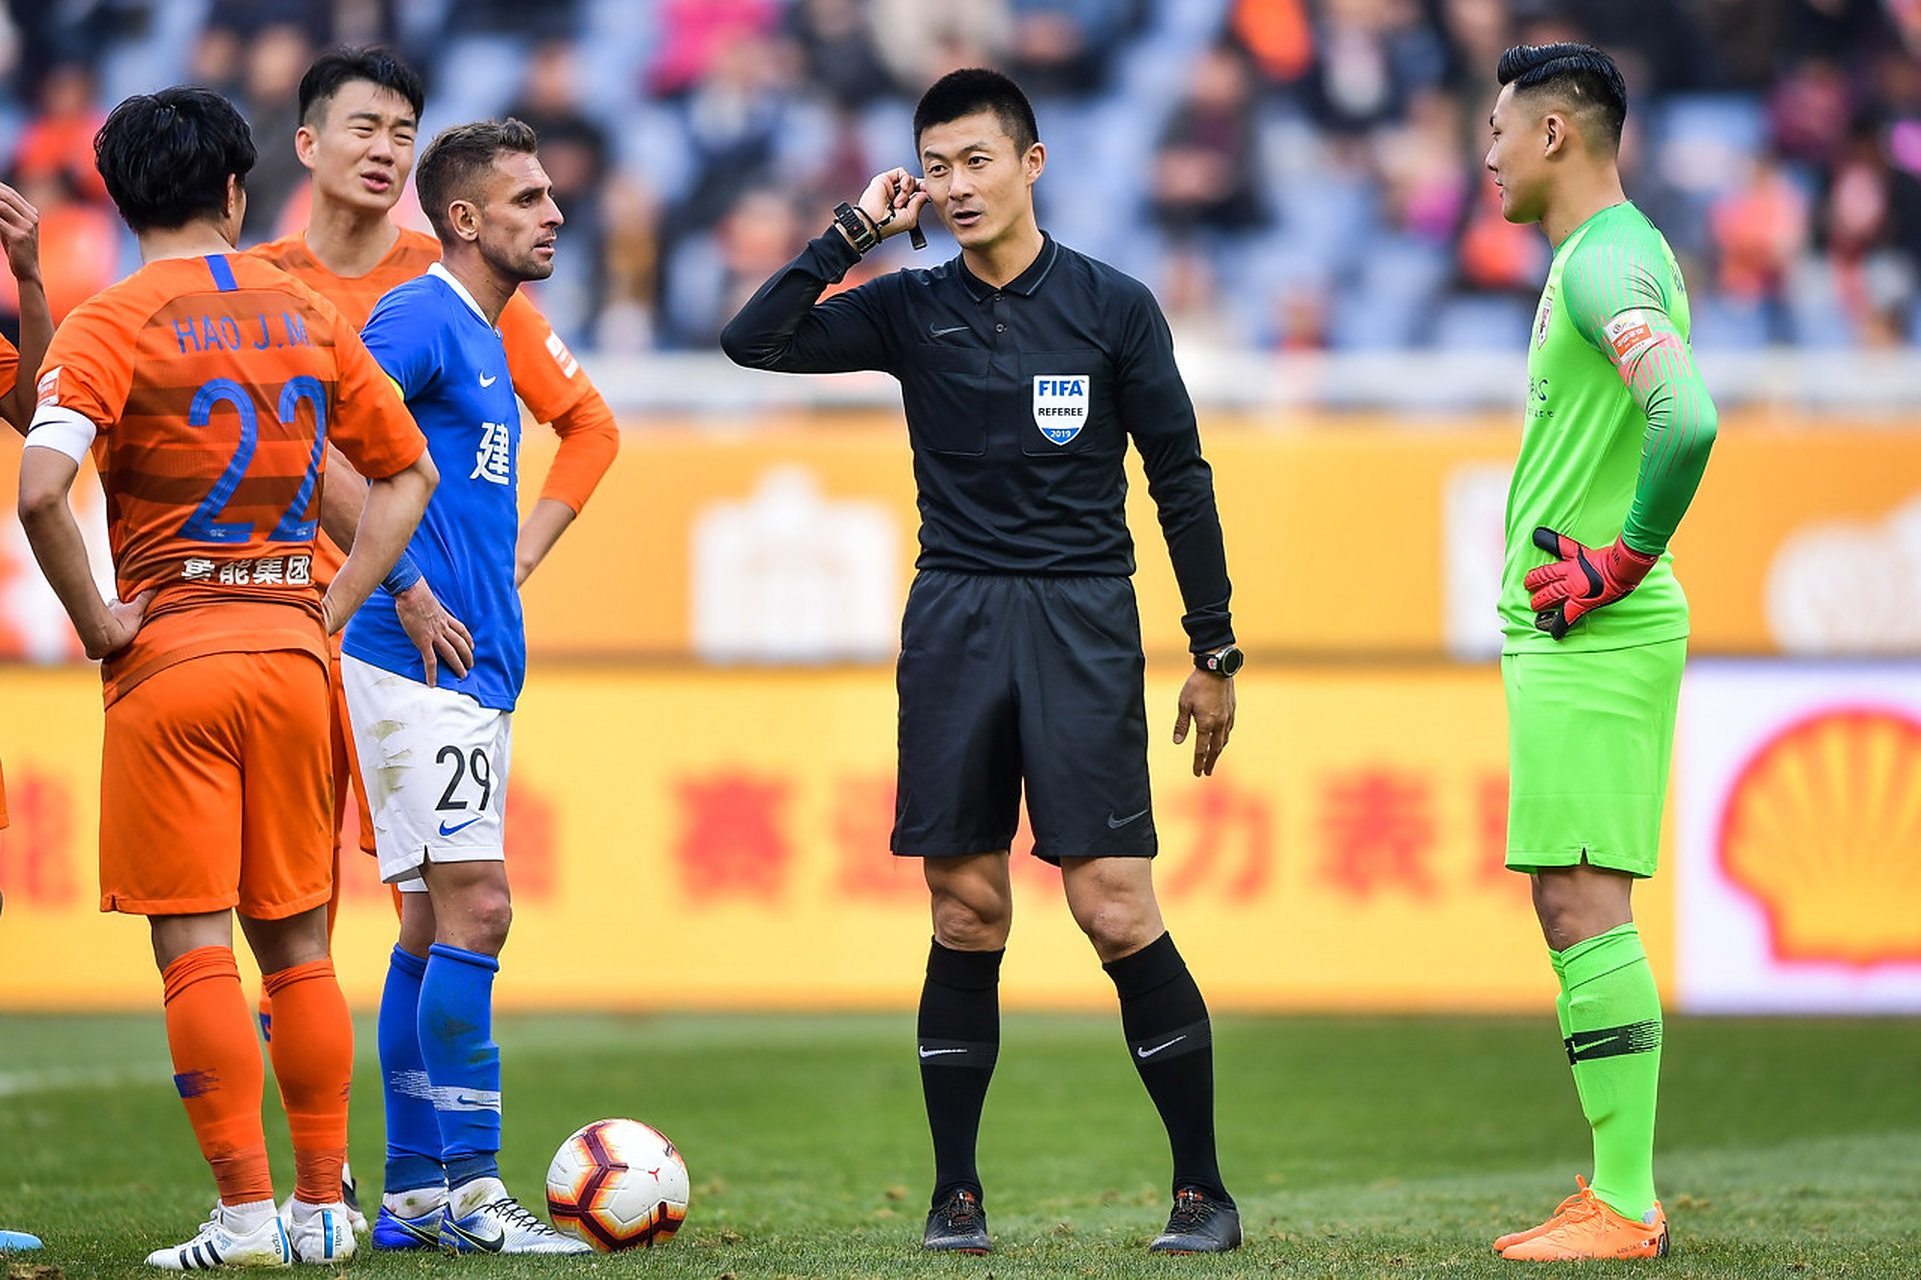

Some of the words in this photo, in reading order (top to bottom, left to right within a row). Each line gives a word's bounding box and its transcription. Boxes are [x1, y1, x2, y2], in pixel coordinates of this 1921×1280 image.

[172, 315, 242, 354] HAO
[1038, 380, 1084, 396] FIFA
[1038, 407, 1084, 417] REFEREE
[469, 421, 521, 486] 建
[1050, 430, 1072, 438] 2019
[173, 375, 329, 544] 22
[434, 745, 491, 811] 29
